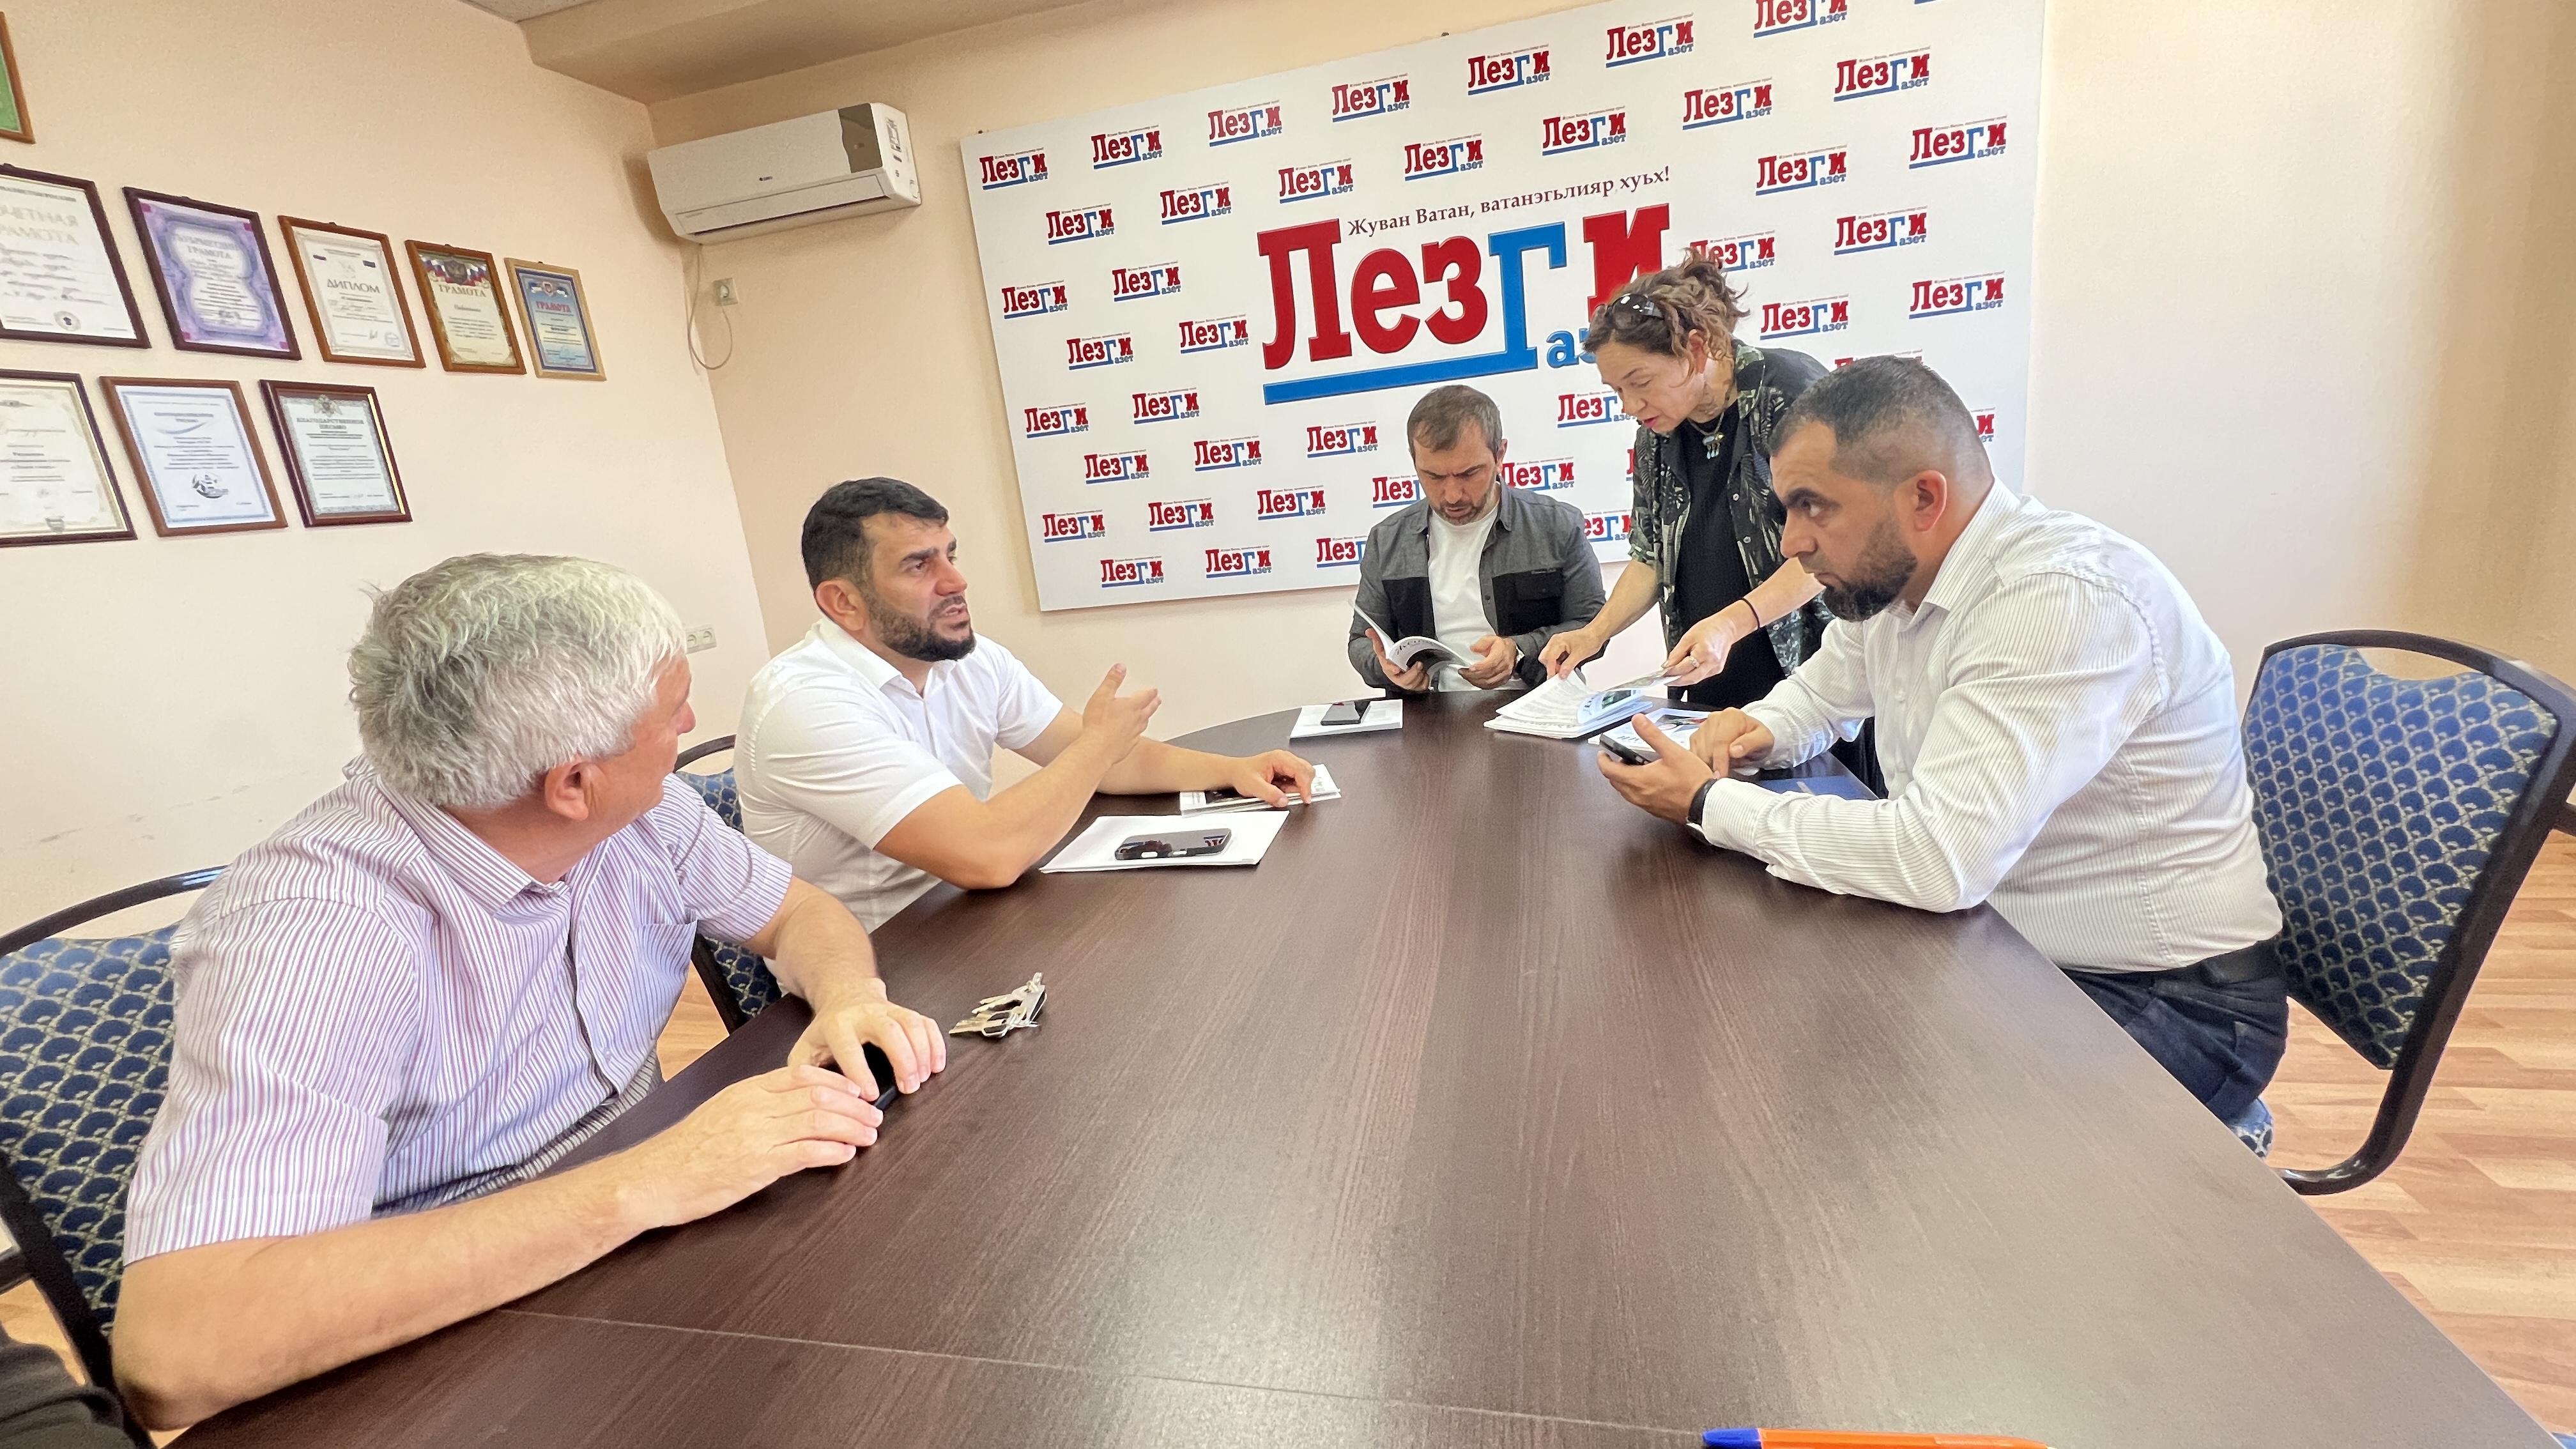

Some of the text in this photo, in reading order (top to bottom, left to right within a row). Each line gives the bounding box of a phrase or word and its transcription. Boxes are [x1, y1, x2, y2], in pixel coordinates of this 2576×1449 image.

[1606, 20, 1693, 59] Лезги
[1468, 50, 1549, 87] Лезги
[1835, 53, 1929, 93] Лезги
[1332, 80, 1409, 114] Лезги
[1683, 84, 1772, 121] Лезги
[1208, 107, 1281, 139] Лезги
[1543, 112, 1625, 148] Лезги
[1091, 131, 1161, 162] Лезги
[1910, 122, 2006, 160] Лезги
[980, 154, 1046, 181] Лезги
[1404, 139, 1483, 173] Лезги
[1757, 151, 1846, 188] Лезги
[1278, 164, 1353, 195] Лезги
[1160, 187, 1230, 217] Лезги
[1347, 165, 1670, 238] Жуван Ватан, ватанэгьлияр хуьх!
[1046, 209, 1113, 236] Лезги
[1836, 212, 1926, 247] Лезги
[326, 279, 380, 294] ДИПЛОМ
[438, 284, 487, 298] ГРАМОТА
[1112, 267, 1179, 294] Лезги
[1257, 203, 1670, 371] Лезги
[1911, 277, 2004, 310] Лезги
[1001, 286, 1066, 311] Лезги
[1761, 300, 1848, 332] Лезги
[1179, 319, 1248, 347] Лезги
[1067, 337, 1133, 363] Лезги
[1132, 392, 1199, 417] Лезги
[1558, 394, 1626, 422] Лезг
[1025, 407, 1087, 432] Лезги
[1307, 425, 1377, 451] Лезги
[1084, 453, 1148, 477] Лезги
[1194, 440, 1261, 465] Лезги
[1257, 489, 1325, 514] Лезги
[1372, 476, 1420, 502] Лезг
[1043, 513, 1105, 536] Лезги
[1148, 501, 1213, 525] Лезги
[1584, 514, 1632, 540] езги
[1206, 548, 1271, 572] Лезги
[1316, 537, 1367, 562] Лезг
[1100, 558, 1163, 581] Лезги
